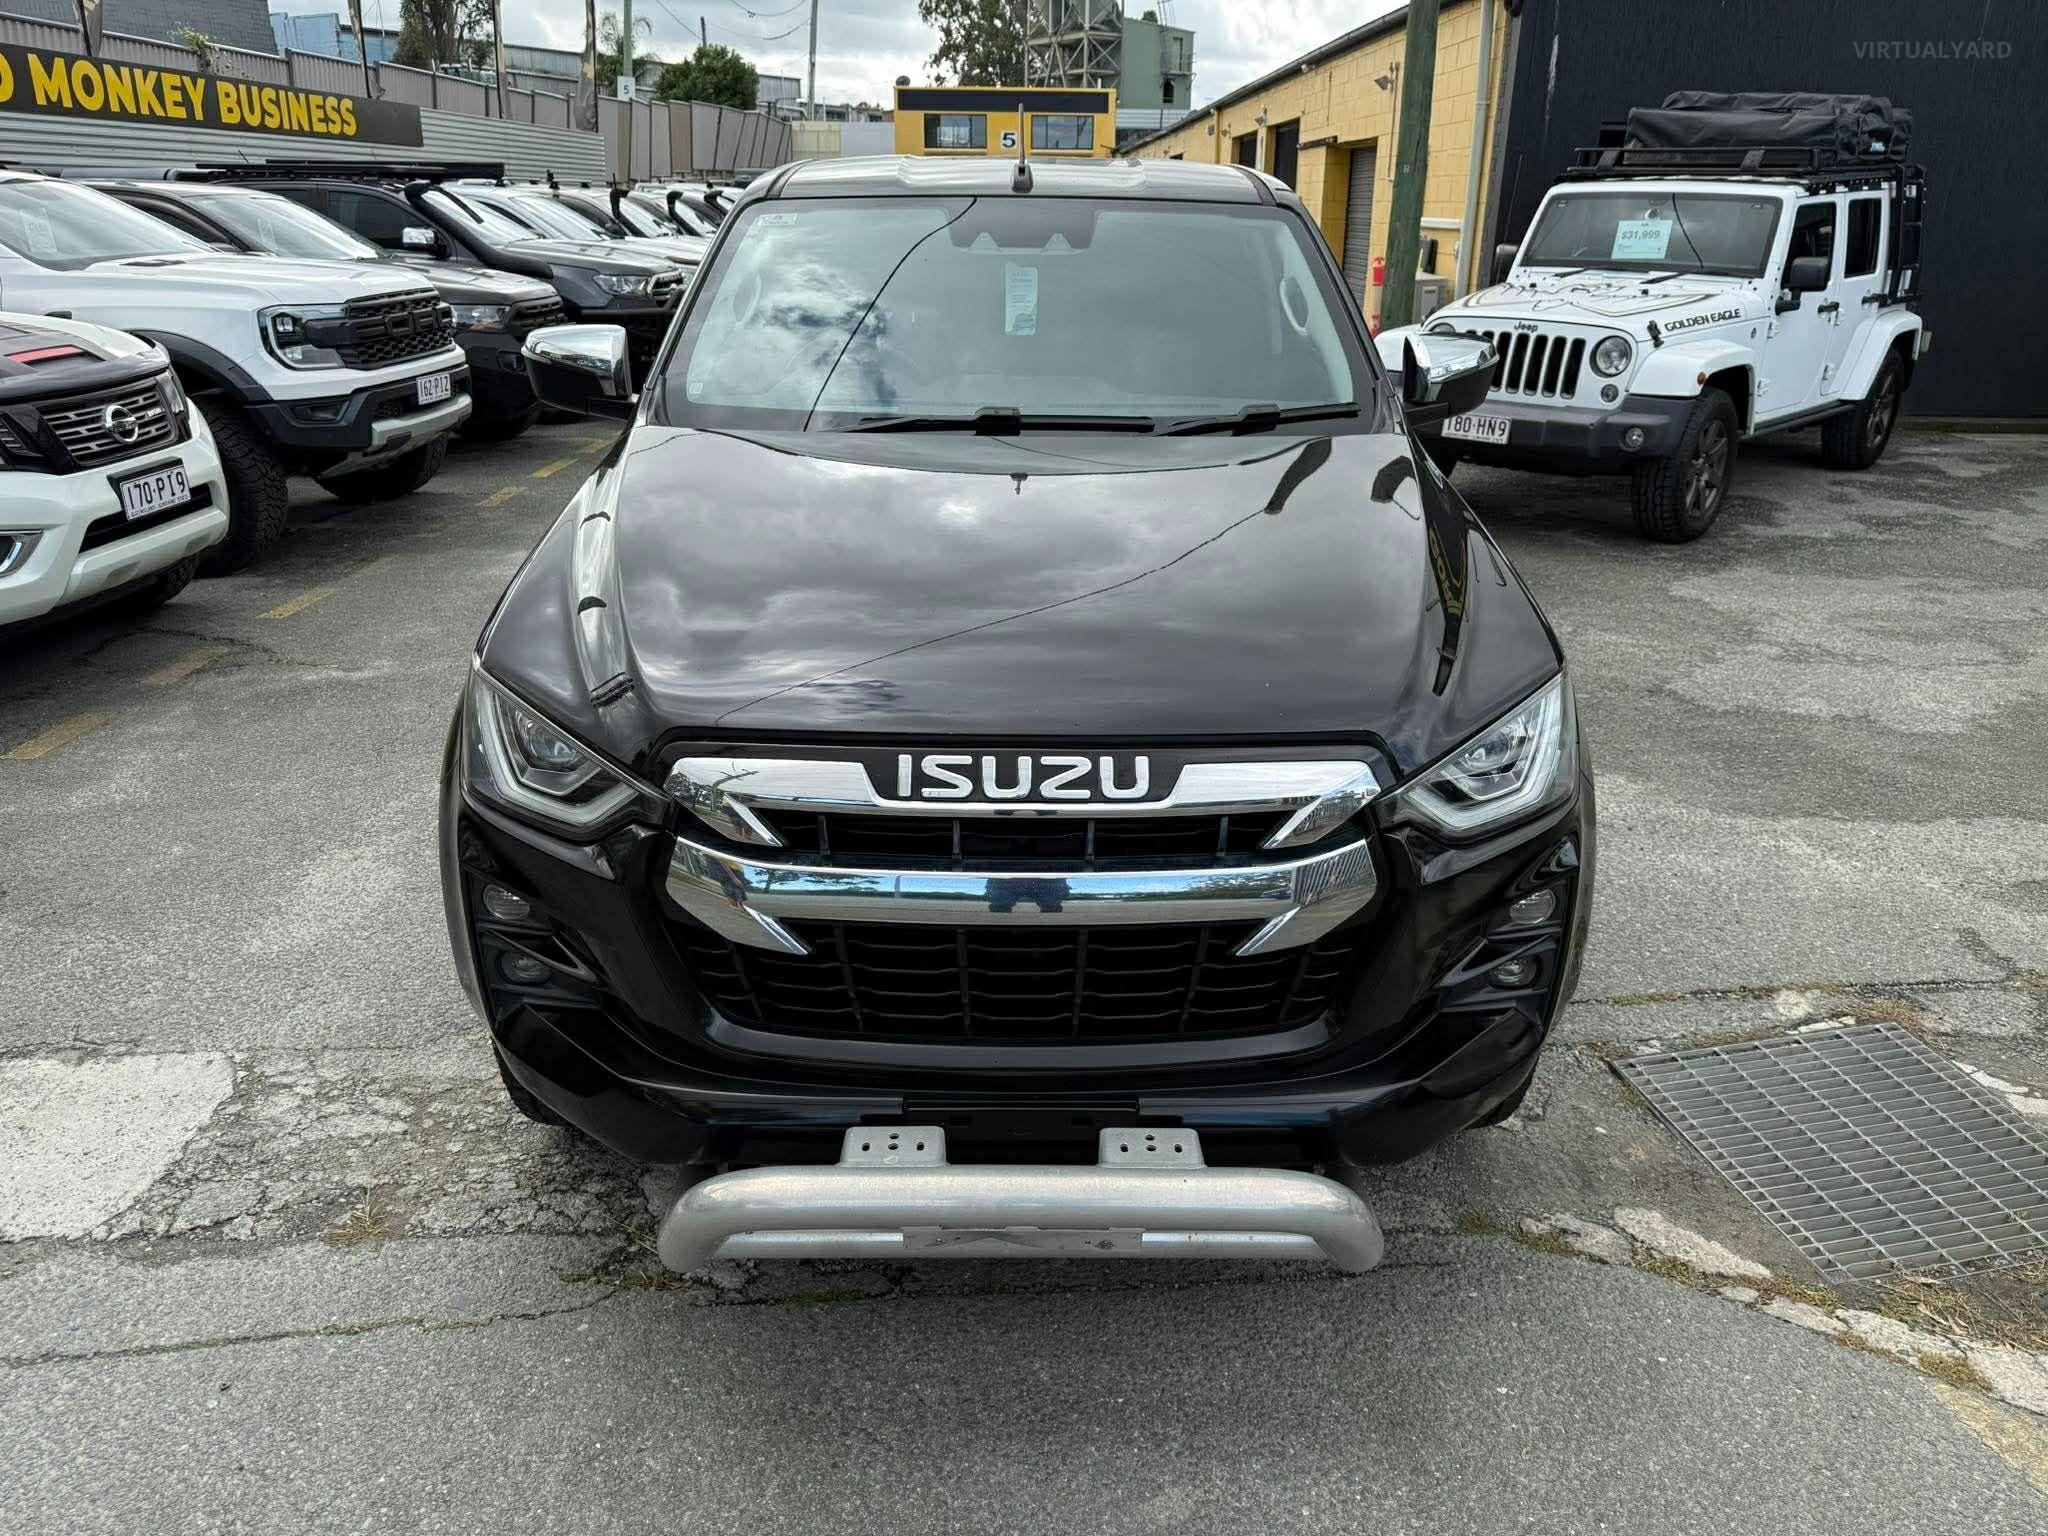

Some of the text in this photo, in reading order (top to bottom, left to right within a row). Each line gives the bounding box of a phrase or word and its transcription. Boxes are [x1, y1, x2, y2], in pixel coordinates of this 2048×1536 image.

[27, 53, 206, 121] MONKEY
[216, 80, 357, 137] BUSINESS
[623, 84, 630, 95] 5
[1002, 132, 1016, 148] 5
[1513, 321, 1538, 333] Jeep
[1664, 308, 1741, 332] GOLDEN EAGLE
[898, 754, 1150, 799] ISUZU
